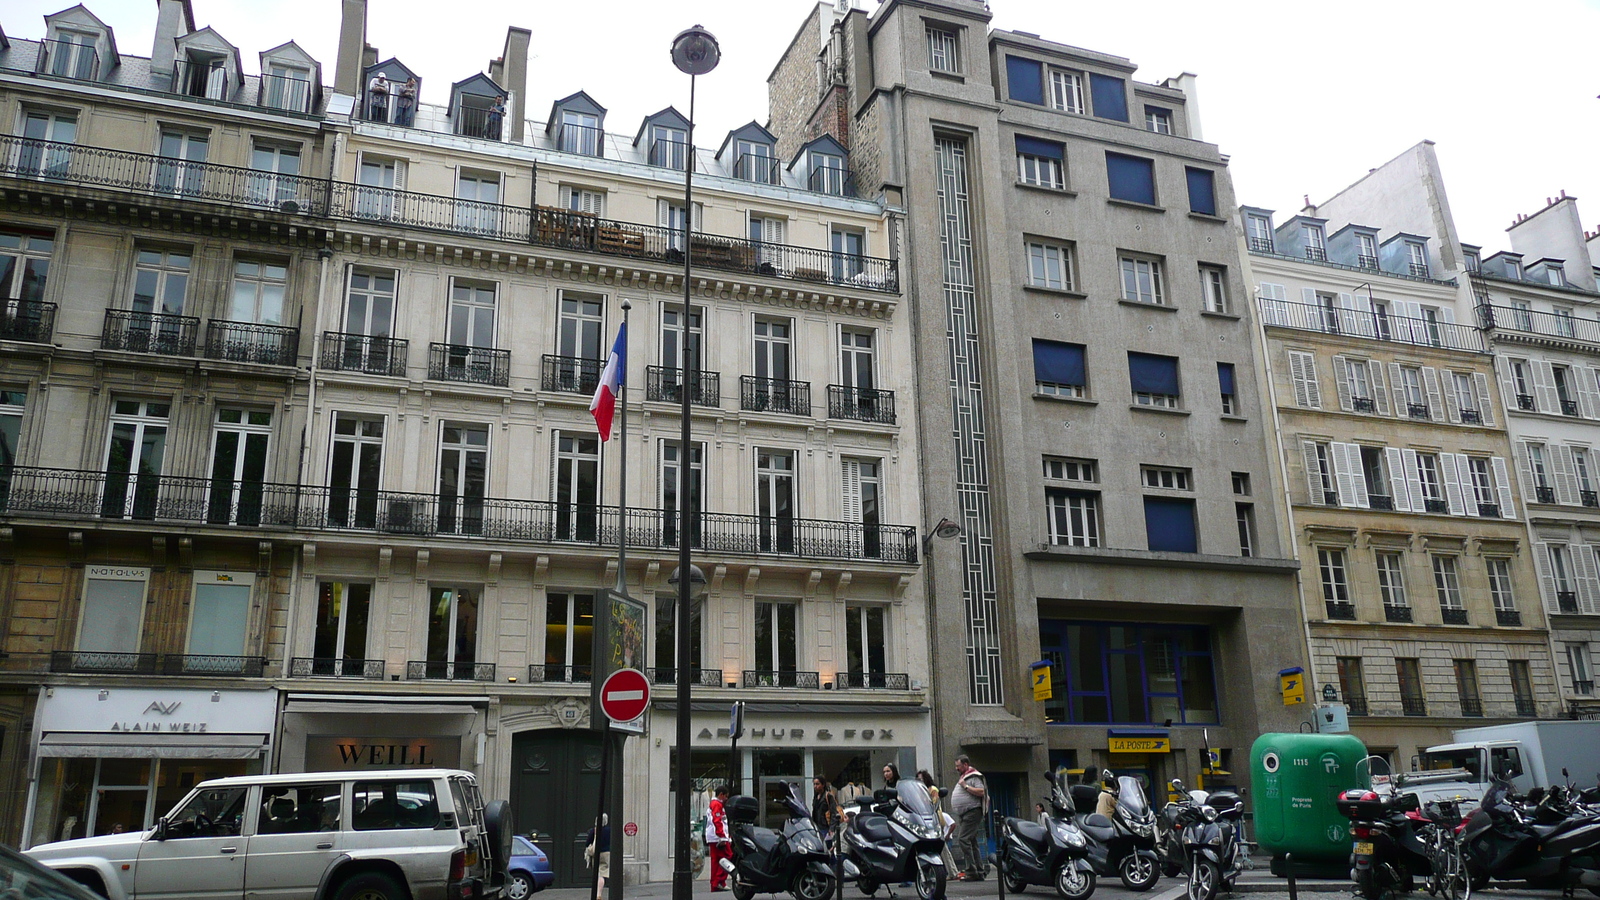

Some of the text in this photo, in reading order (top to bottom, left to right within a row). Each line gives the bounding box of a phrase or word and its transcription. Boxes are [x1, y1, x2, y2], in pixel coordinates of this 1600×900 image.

[111, 721, 207, 732] ALAIN WEIZ
[697, 727, 894, 740] ARHUR & FOX
[1114, 741, 1152, 750] LA POSTE
[336, 744, 434, 765] WEILL
